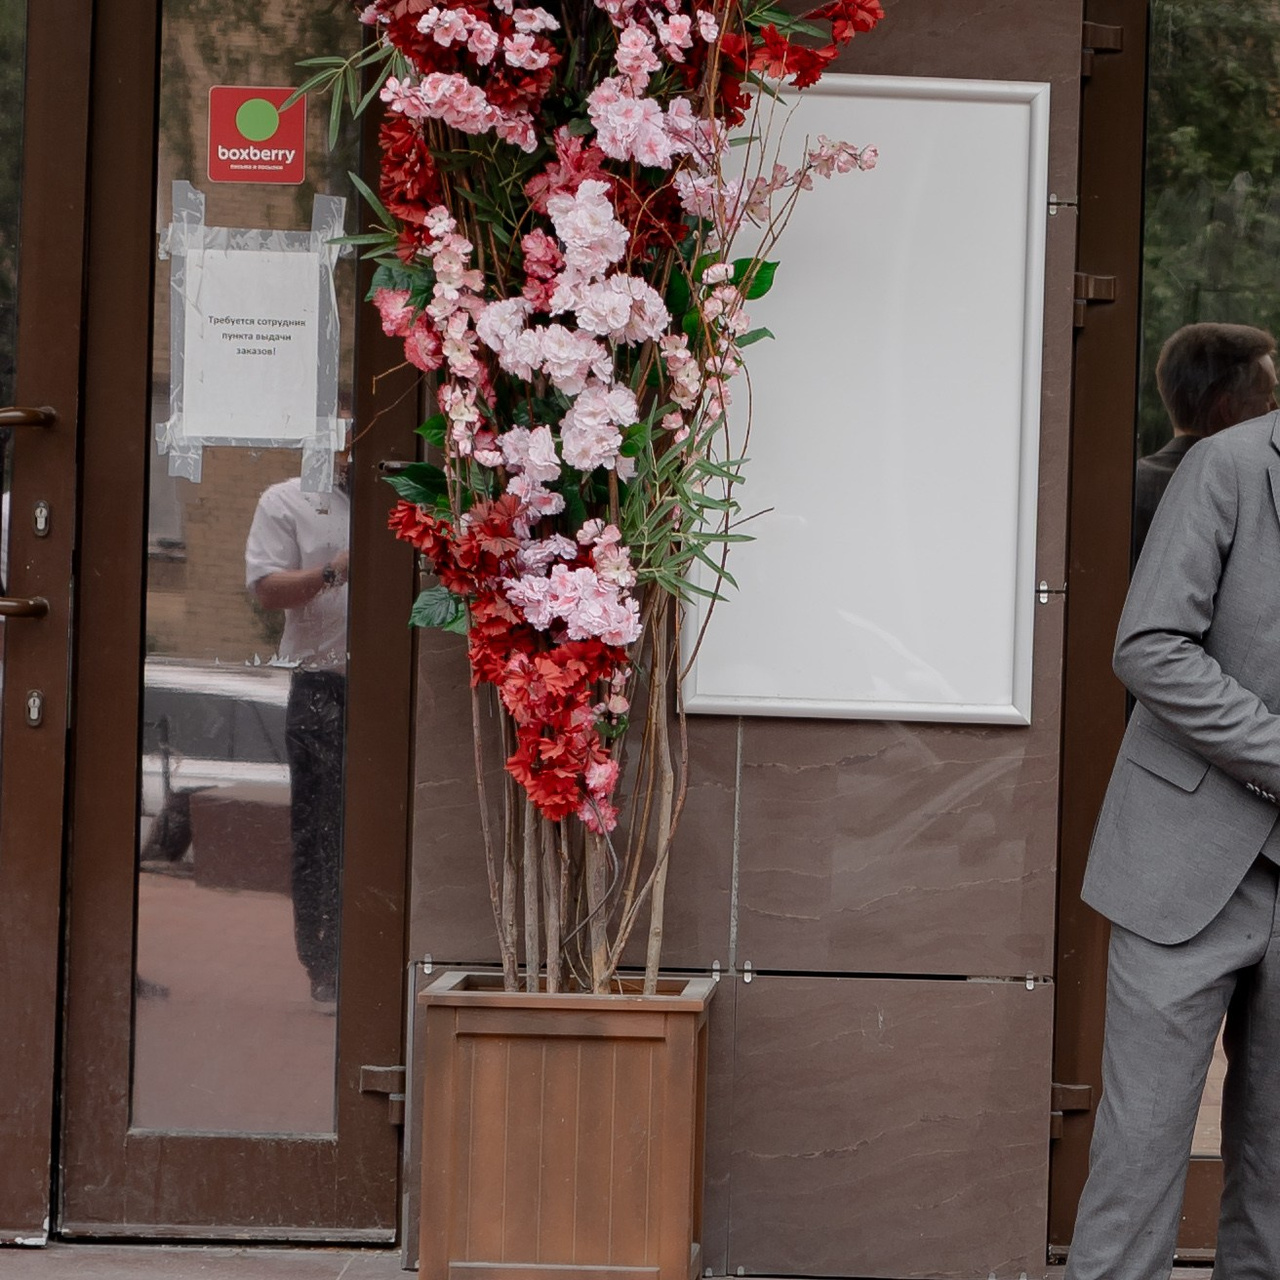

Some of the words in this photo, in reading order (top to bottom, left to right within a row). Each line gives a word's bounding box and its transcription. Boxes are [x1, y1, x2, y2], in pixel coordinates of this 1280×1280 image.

[218, 145, 295, 164] boxberry
[208, 315, 255, 326] Требуется
[222, 332, 254, 341] пункта
[255, 333, 292, 342] выдачи
[236, 347, 276, 356] заказов!
